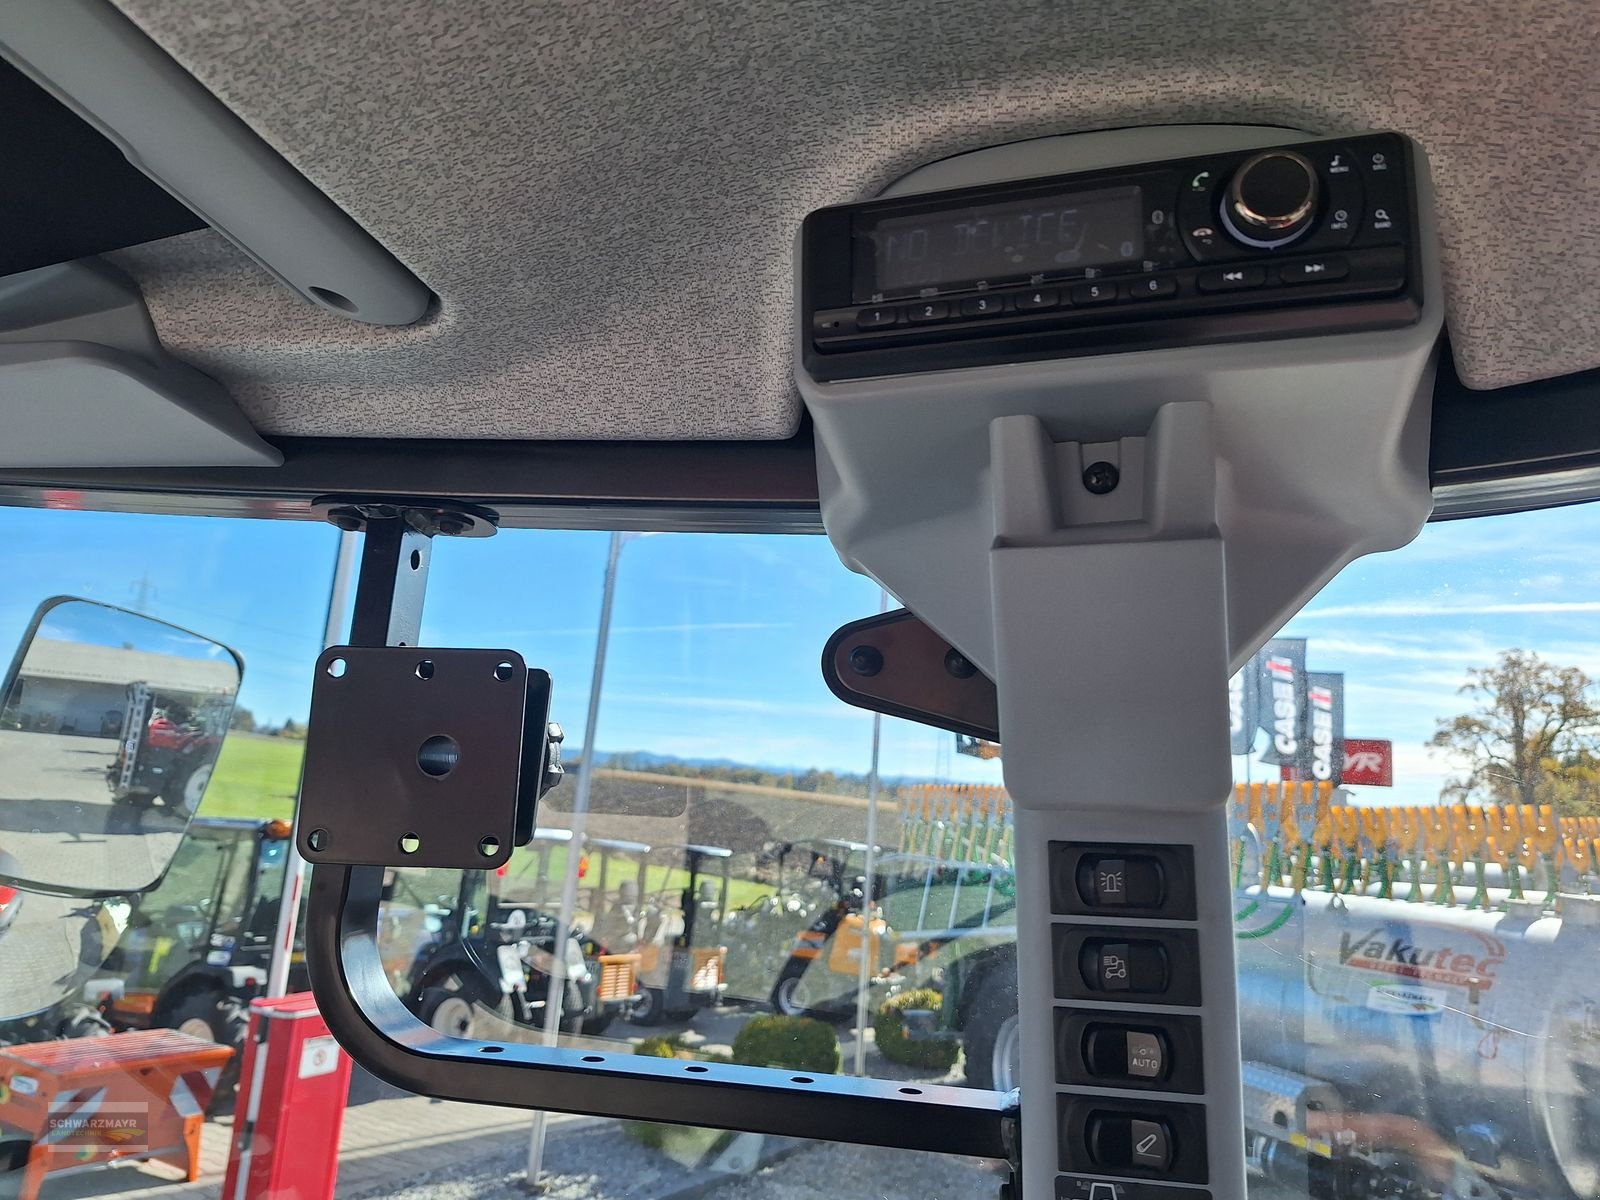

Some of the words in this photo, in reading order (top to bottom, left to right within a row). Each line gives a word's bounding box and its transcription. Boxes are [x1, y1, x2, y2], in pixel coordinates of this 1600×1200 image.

[874, 311, 880, 321] 1
[925, 306, 933, 316] 2
[978, 300, 986, 310] 3
[1033, 293, 1041, 303] 4
[1090, 287, 1099, 297] 5
[1148, 280, 1157, 290] 6
[1273, 681, 1297, 754] CASE
[1312, 708, 1332, 780] CASE
[1339, 928, 1502, 977] Vakutec
[1132, 1057, 1158, 1069] AUTO
